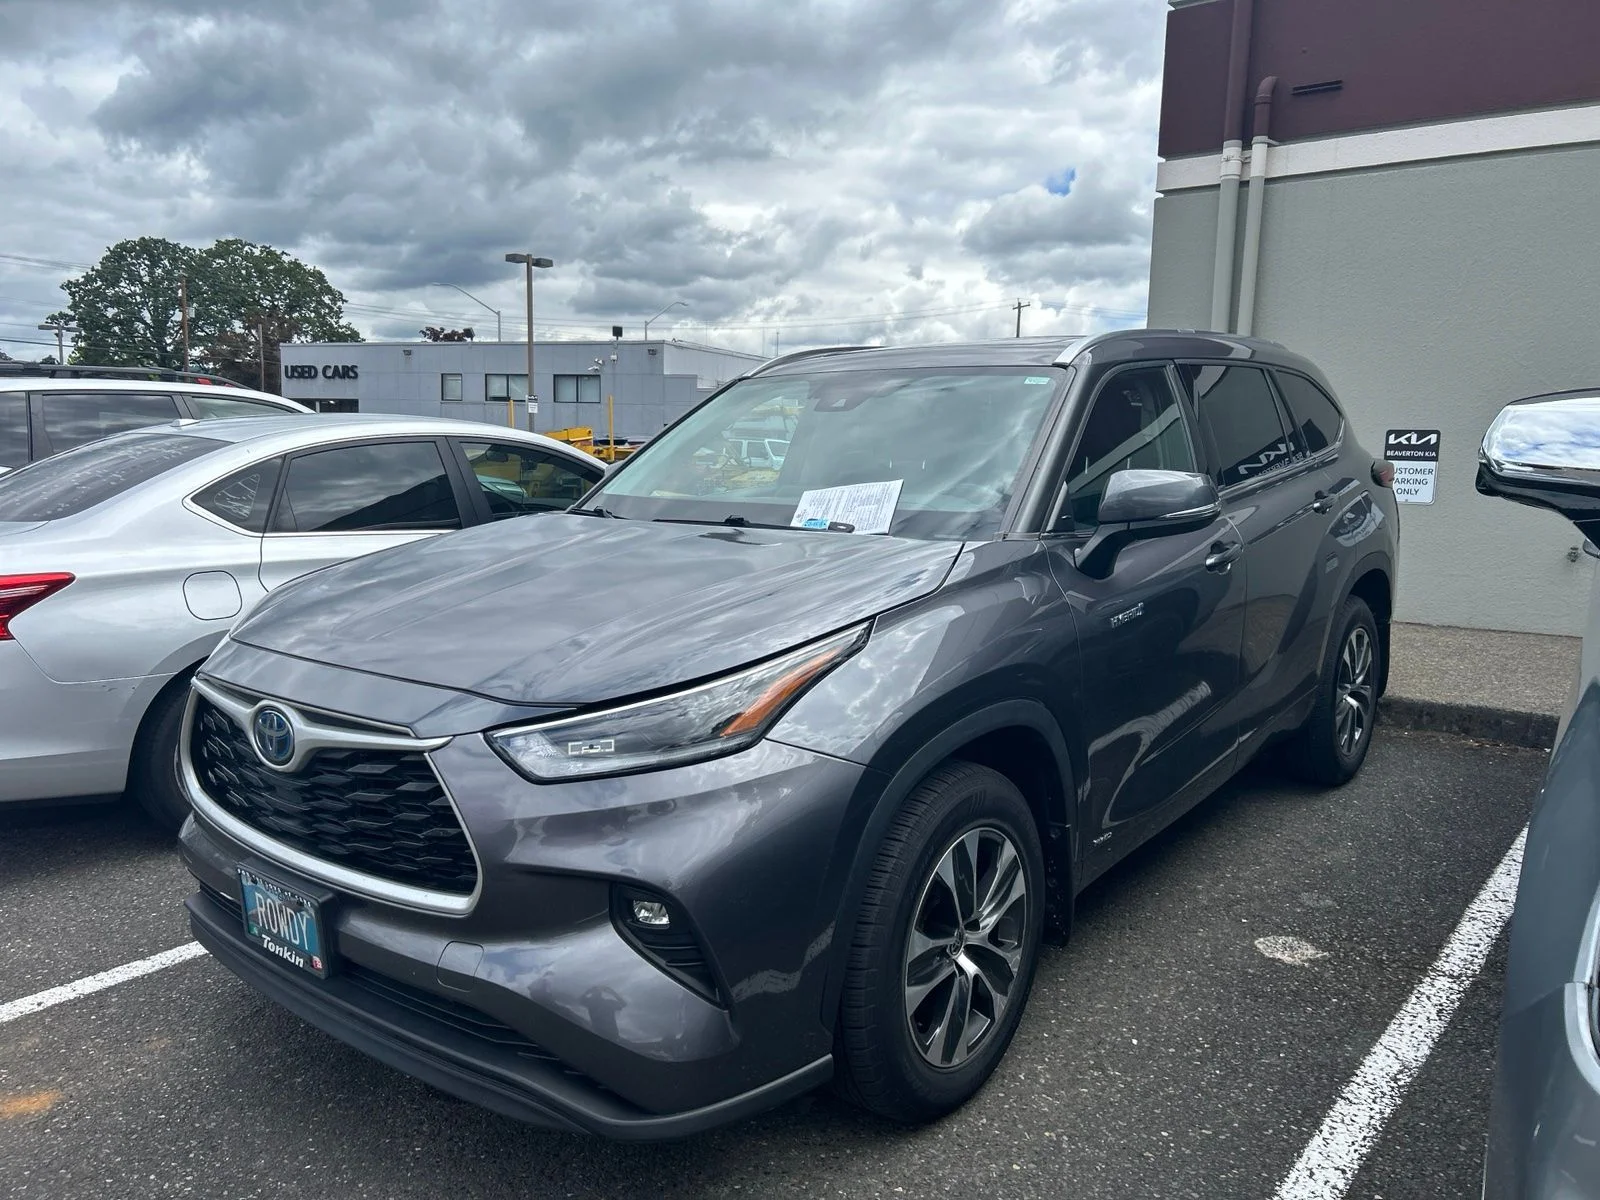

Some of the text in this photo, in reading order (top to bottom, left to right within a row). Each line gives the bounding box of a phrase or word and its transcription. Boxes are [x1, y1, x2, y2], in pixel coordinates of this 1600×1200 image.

[284, 365, 358, 379] USED CARS
[1393, 477, 1428, 486] ARKING
[1396, 488, 1420, 496] ONLY
[255, 892, 308, 951] ROWDY
[261, 934, 304, 968] Tonkin
